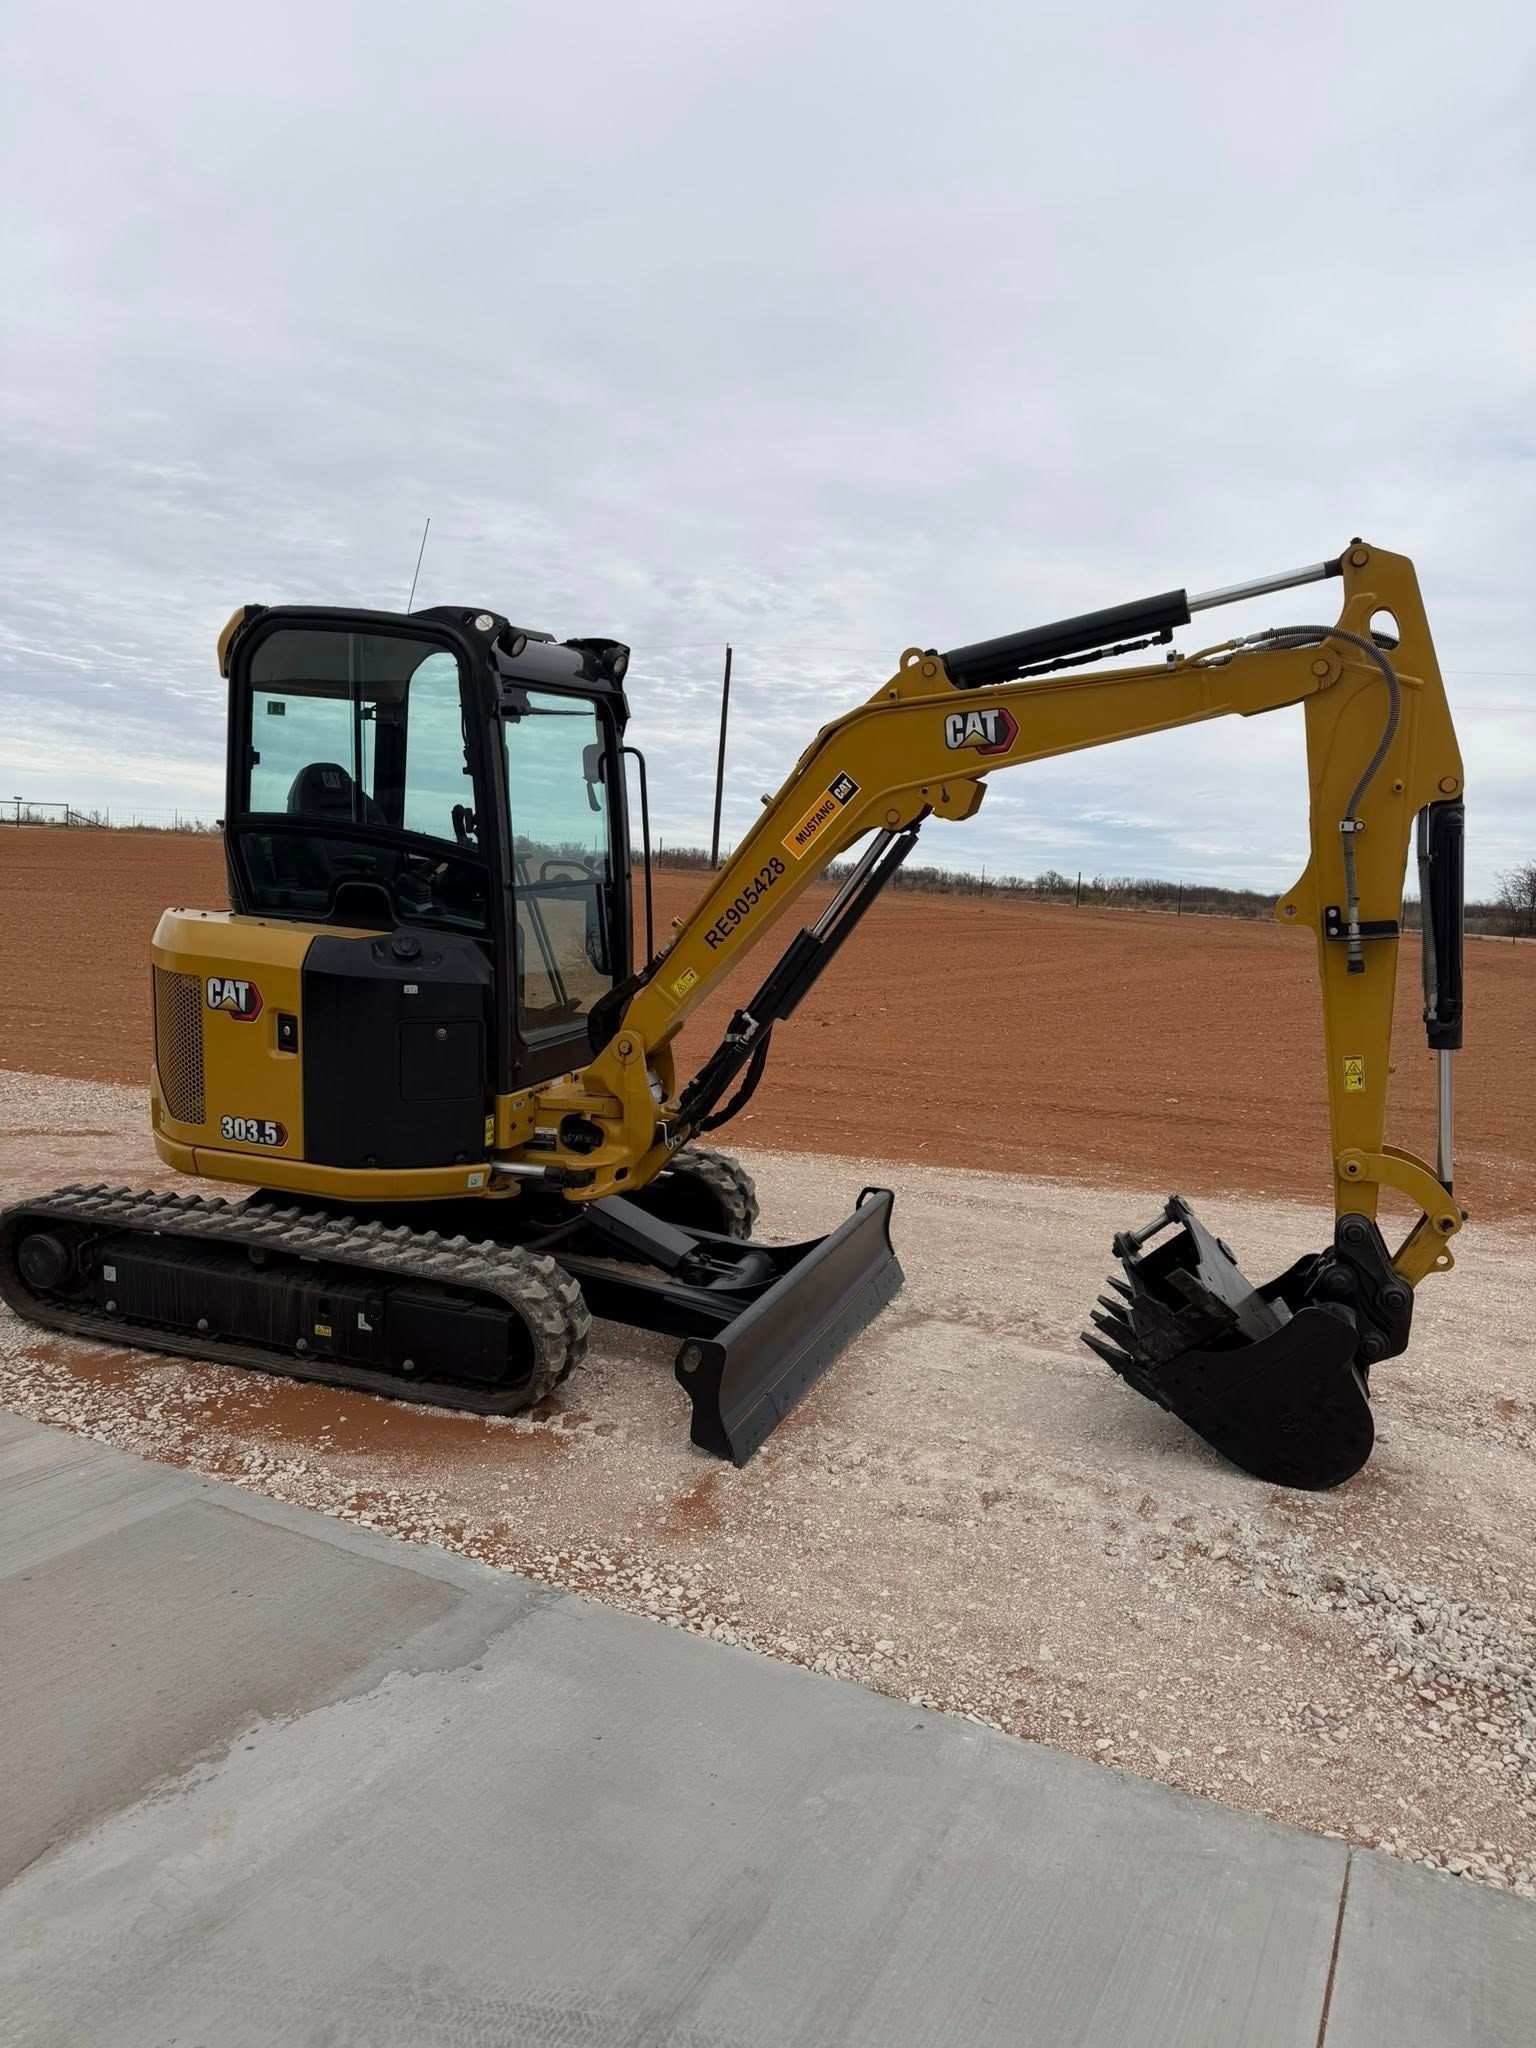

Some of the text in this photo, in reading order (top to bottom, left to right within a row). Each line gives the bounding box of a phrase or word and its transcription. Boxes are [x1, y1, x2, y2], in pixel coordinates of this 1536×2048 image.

[946, 709, 999, 748] CAT
[321, 771, 341, 789] CAT
[795, 778, 853, 845] MUSTANG CAT
[704, 857, 785, 950] RE905428
[207, 978, 249, 1011] CAT
[221, 1116, 277, 1144] 303.5
